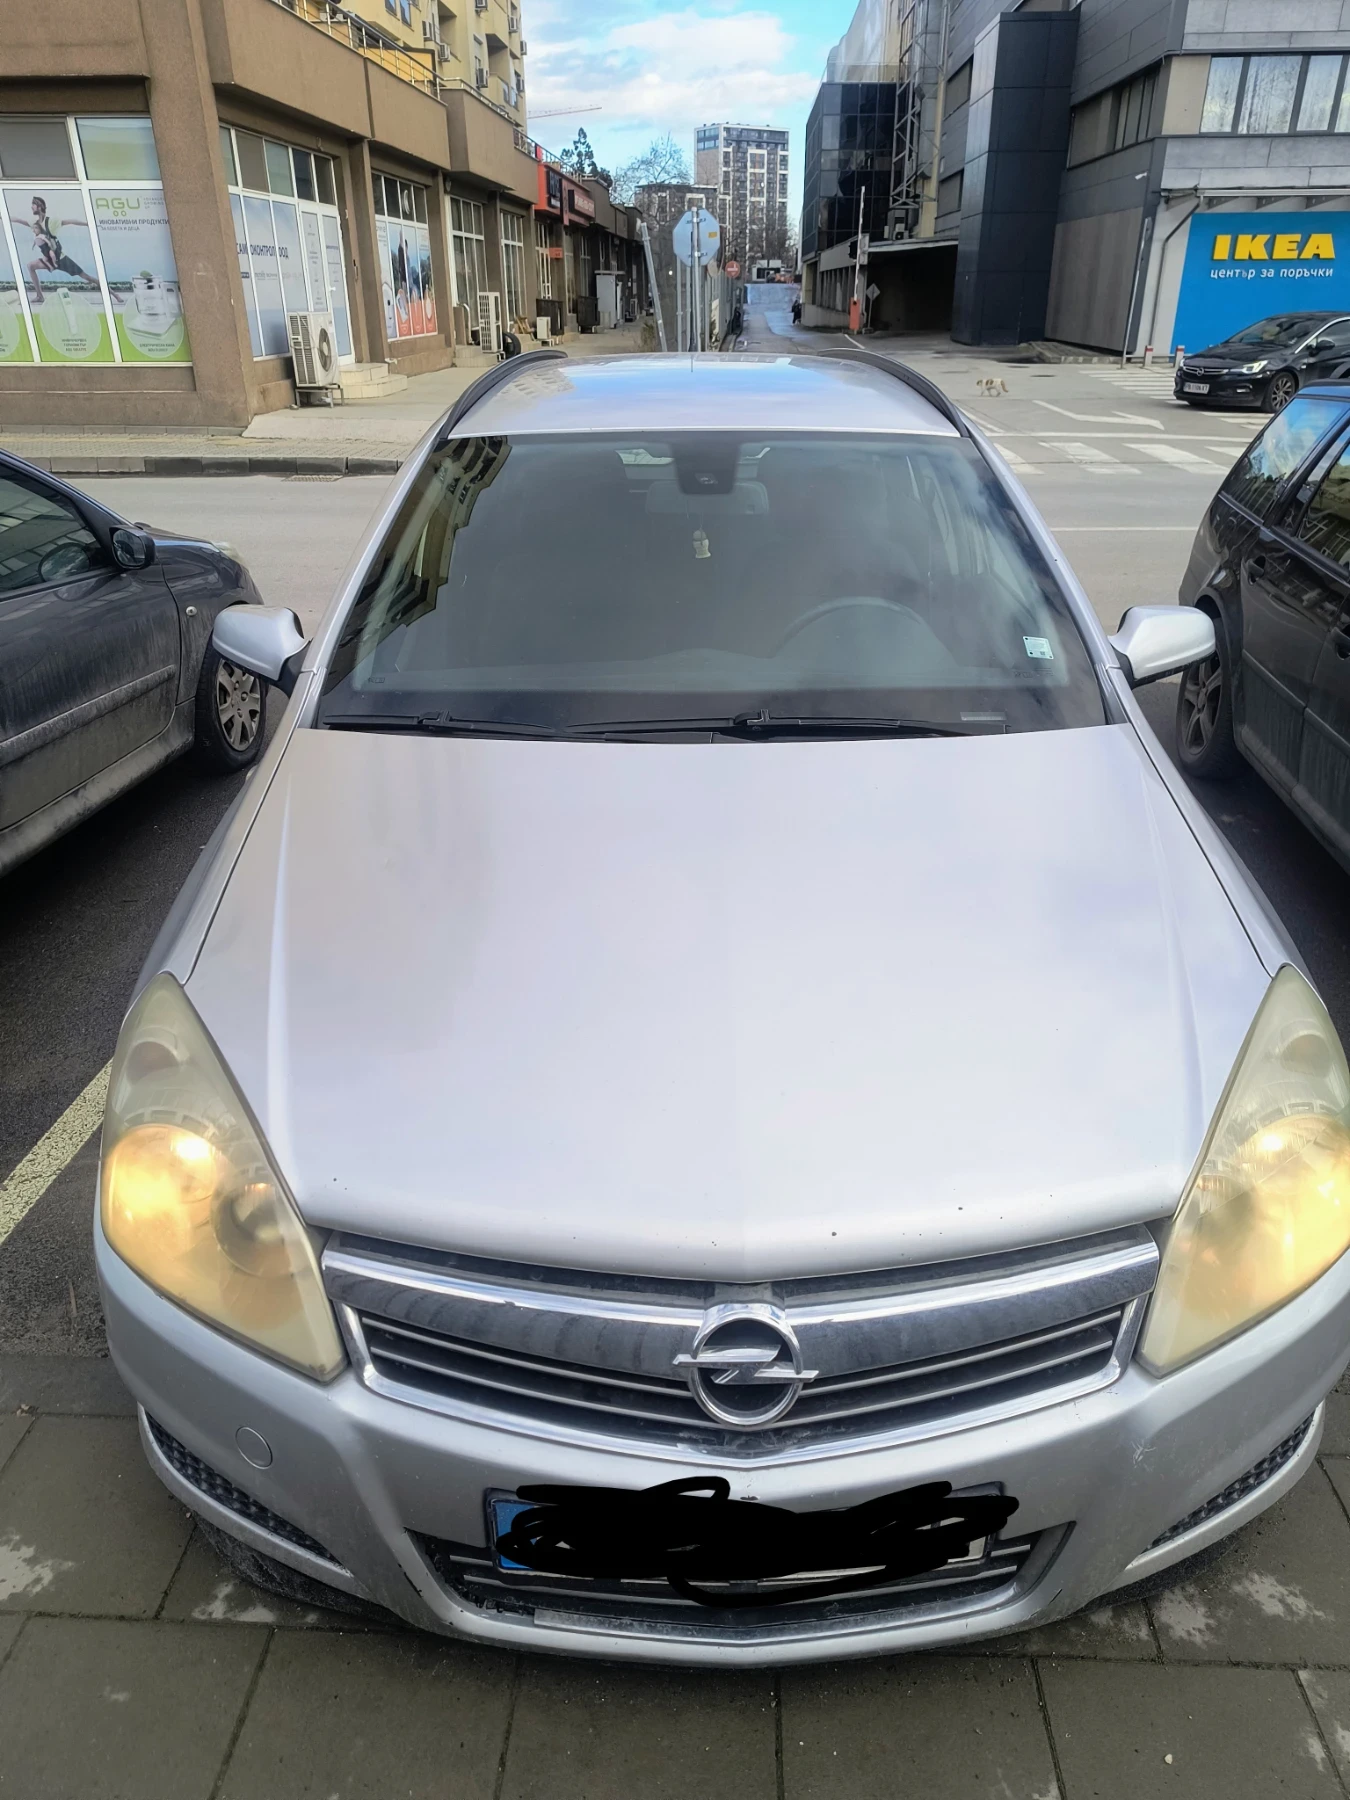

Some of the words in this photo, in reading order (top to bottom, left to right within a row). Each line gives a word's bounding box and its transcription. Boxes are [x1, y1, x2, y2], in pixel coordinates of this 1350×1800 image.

[95, 197, 140, 209] AGU
[1212, 233, 1336, 260] IKEA
[1210, 268, 1256, 280] център
[1260, 268, 1275, 278] за
[1280, 268, 1333, 279] поръчки
